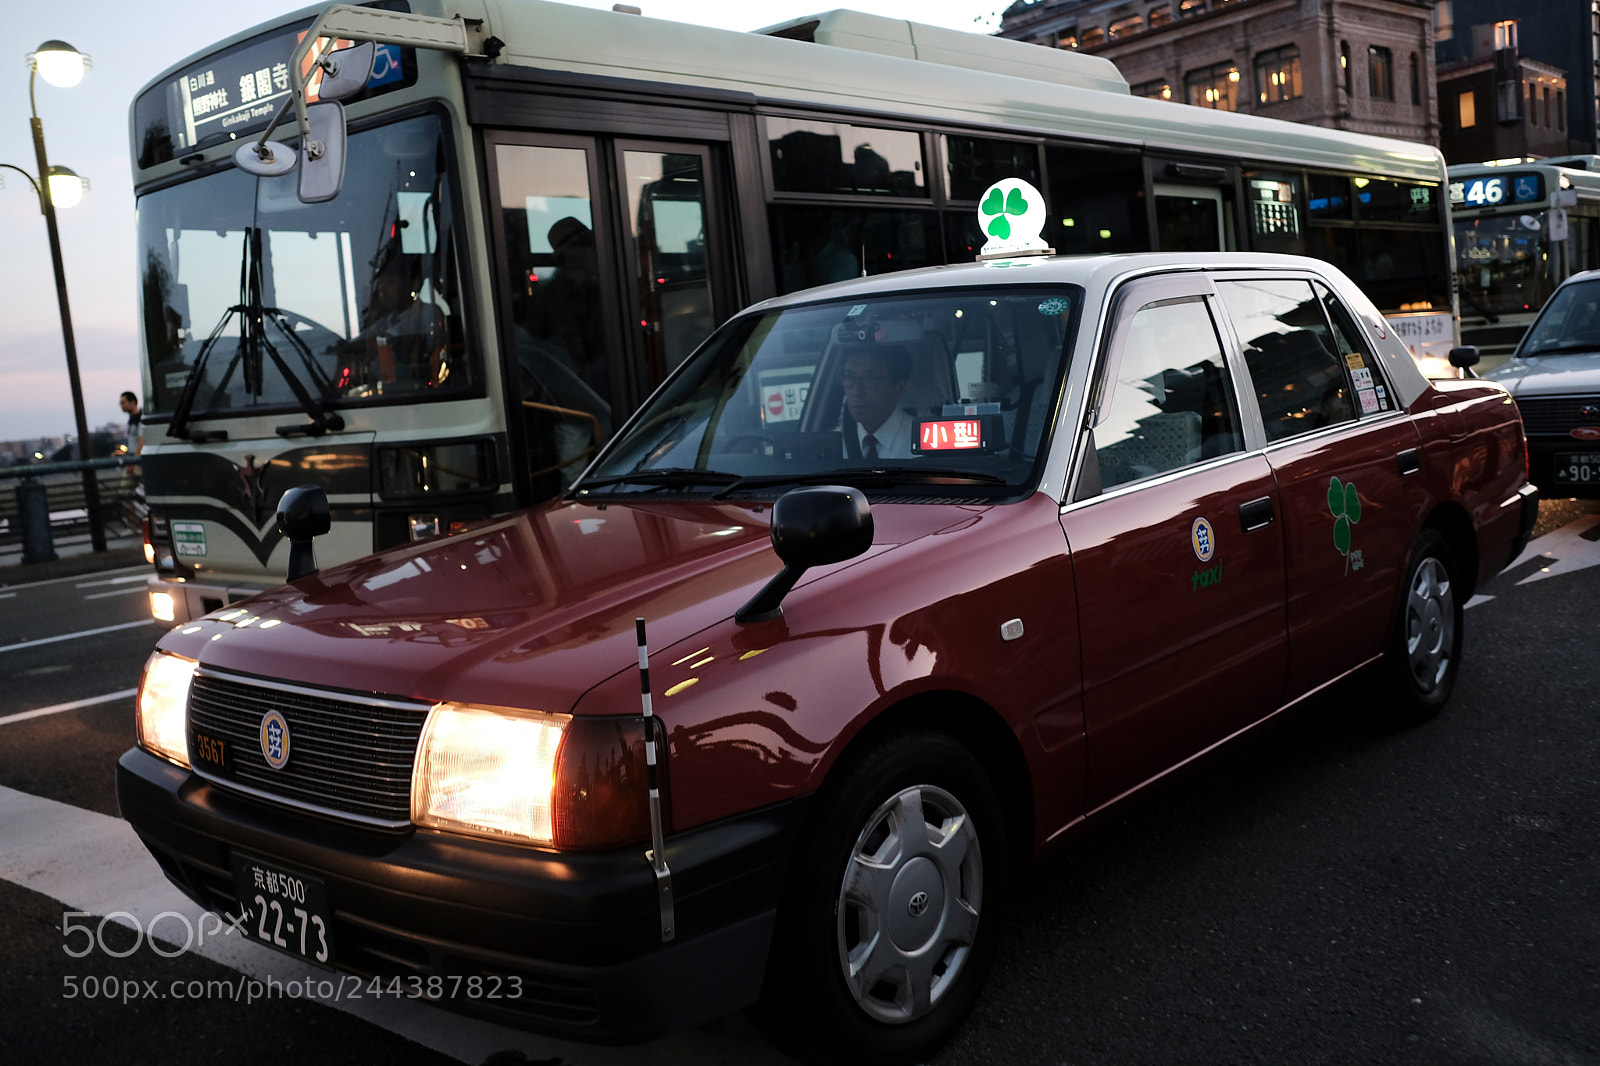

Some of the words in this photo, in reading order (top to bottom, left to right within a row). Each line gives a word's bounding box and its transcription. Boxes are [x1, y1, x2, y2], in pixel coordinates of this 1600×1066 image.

[239, 62, 289, 103] 銀閣寺
[1467, 178, 1503, 205] 46
[922, 422, 979, 449] 小型
[1191, 558, 1223, 591] taxi
[198, 734, 225, 767] 3567
[252, 865, 305, 904] 京都500
[254, 894, 328, 963] 22-73
